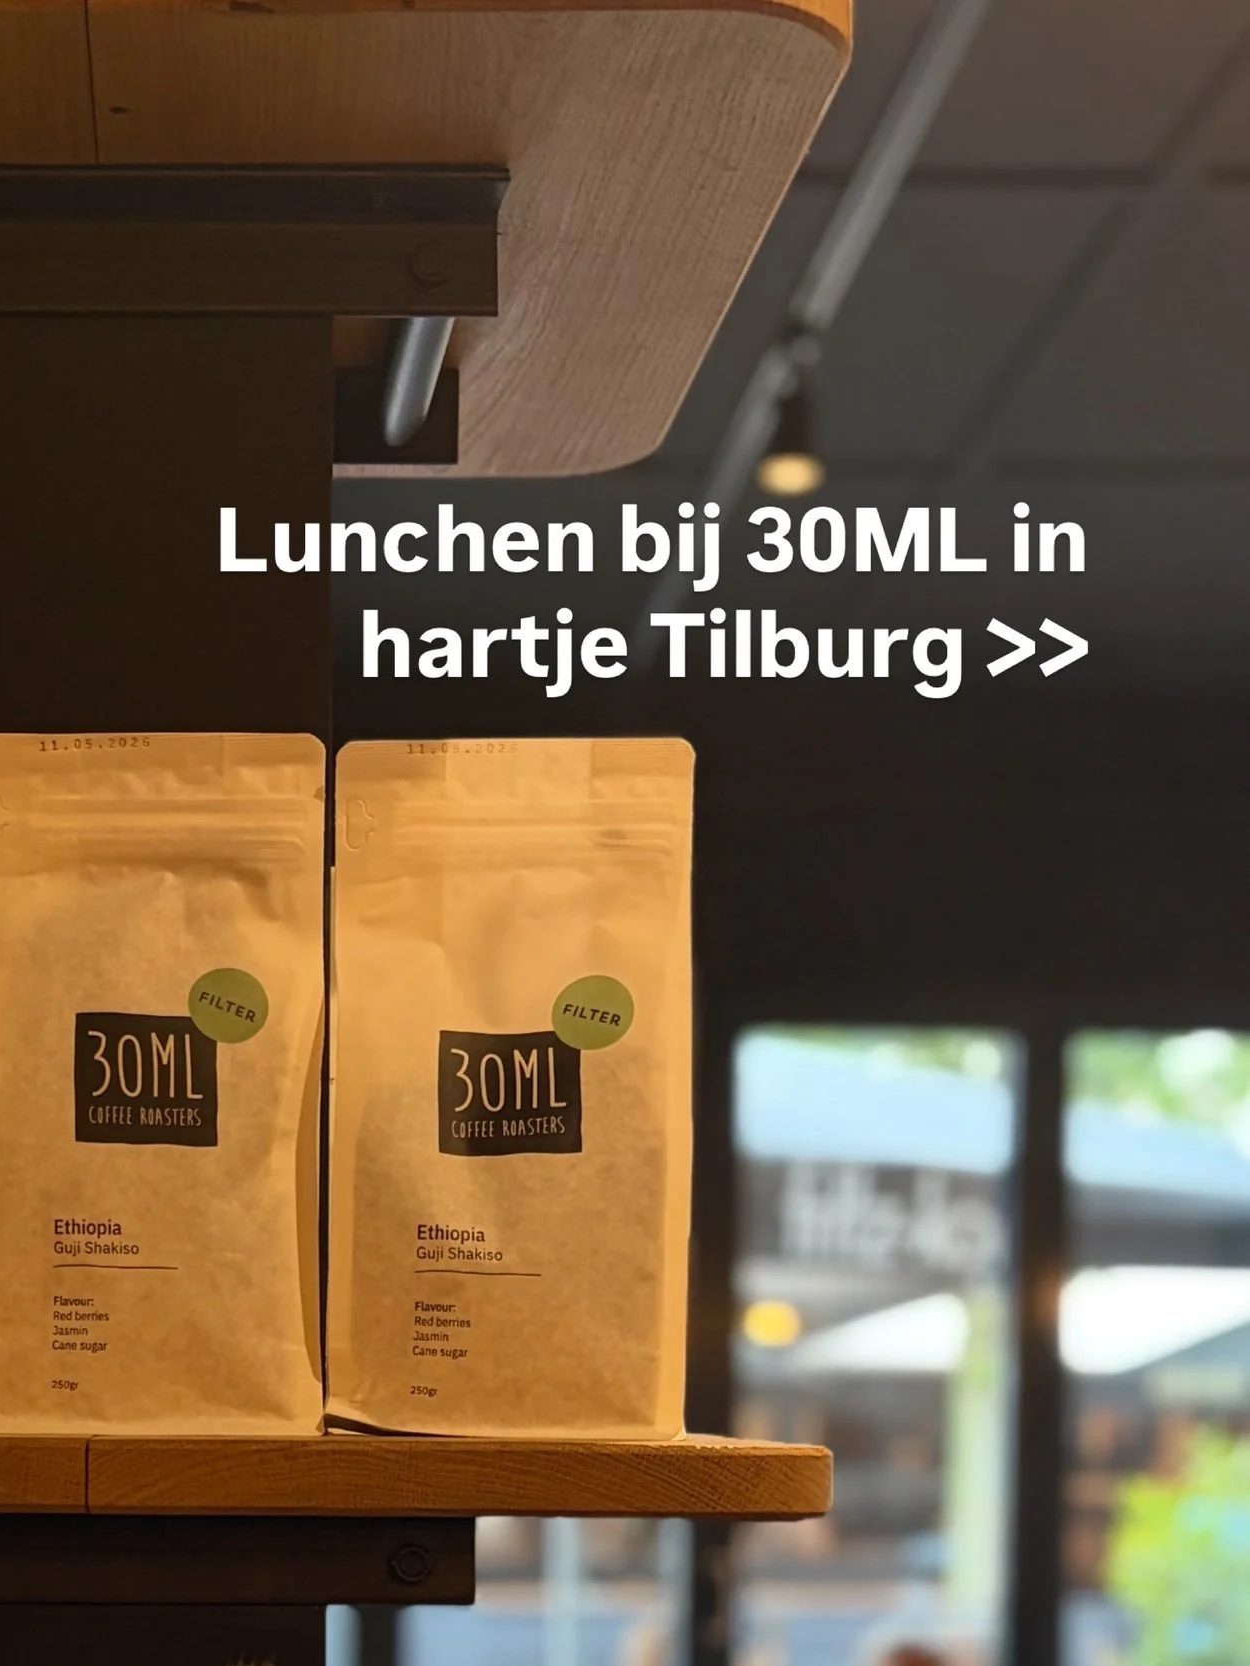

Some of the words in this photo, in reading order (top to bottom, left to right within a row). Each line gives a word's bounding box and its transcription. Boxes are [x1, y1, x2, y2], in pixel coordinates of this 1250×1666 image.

[39, 736, 150, 752] 11.05.2026
[198, 991, 256, 1023] FILTER
[562, 1003, 622, 1027] FILTER
[88, 1030, 204, 1099] 30ML
[451, 1047, 567, 1113] 30ML
[88, 1105, 133, 1125] COFFEE
[140, 1106, 202, 1127] ROASTERS
[451, 1120, 495, 1138] COFFEE
[502, 1116, 566, 1137] ROASTERS
[53, 1219, 123, 1239] Ethiopia
[417, 1224, 486, 1245] Ethiopia
[53, 1241, 81, 1257] Guji
[85, 1241, 140, 1256] Shakiso
[416, 1246, 444, 1262] Guji
[448, 1246, 503, 1262] Shakiso
[53, 1296, 95, 1307] Flavour:
[414, 1301, 456, 1313] Flavour:
[53, 1311, 72, 1321] Red
[75, 1311, 110, 1322] berries
[414, 1316, 434, 1327] Red
[436, 1316, 472, 1328] berries
[52, 1325, 88, 1336] Jasmin
[413, 1331, 449, 1342] Jasmin
[52, 1340, 77, 1351] Cane
[80, 1341, 108, 1353] sugar
[412, 1345, 438, 1357] Cane
[440, 1347, 468, 1360] sugar
[51, 1380, 79, 1391] 250gr
[410, 1385, 438, 1398] 250gr
